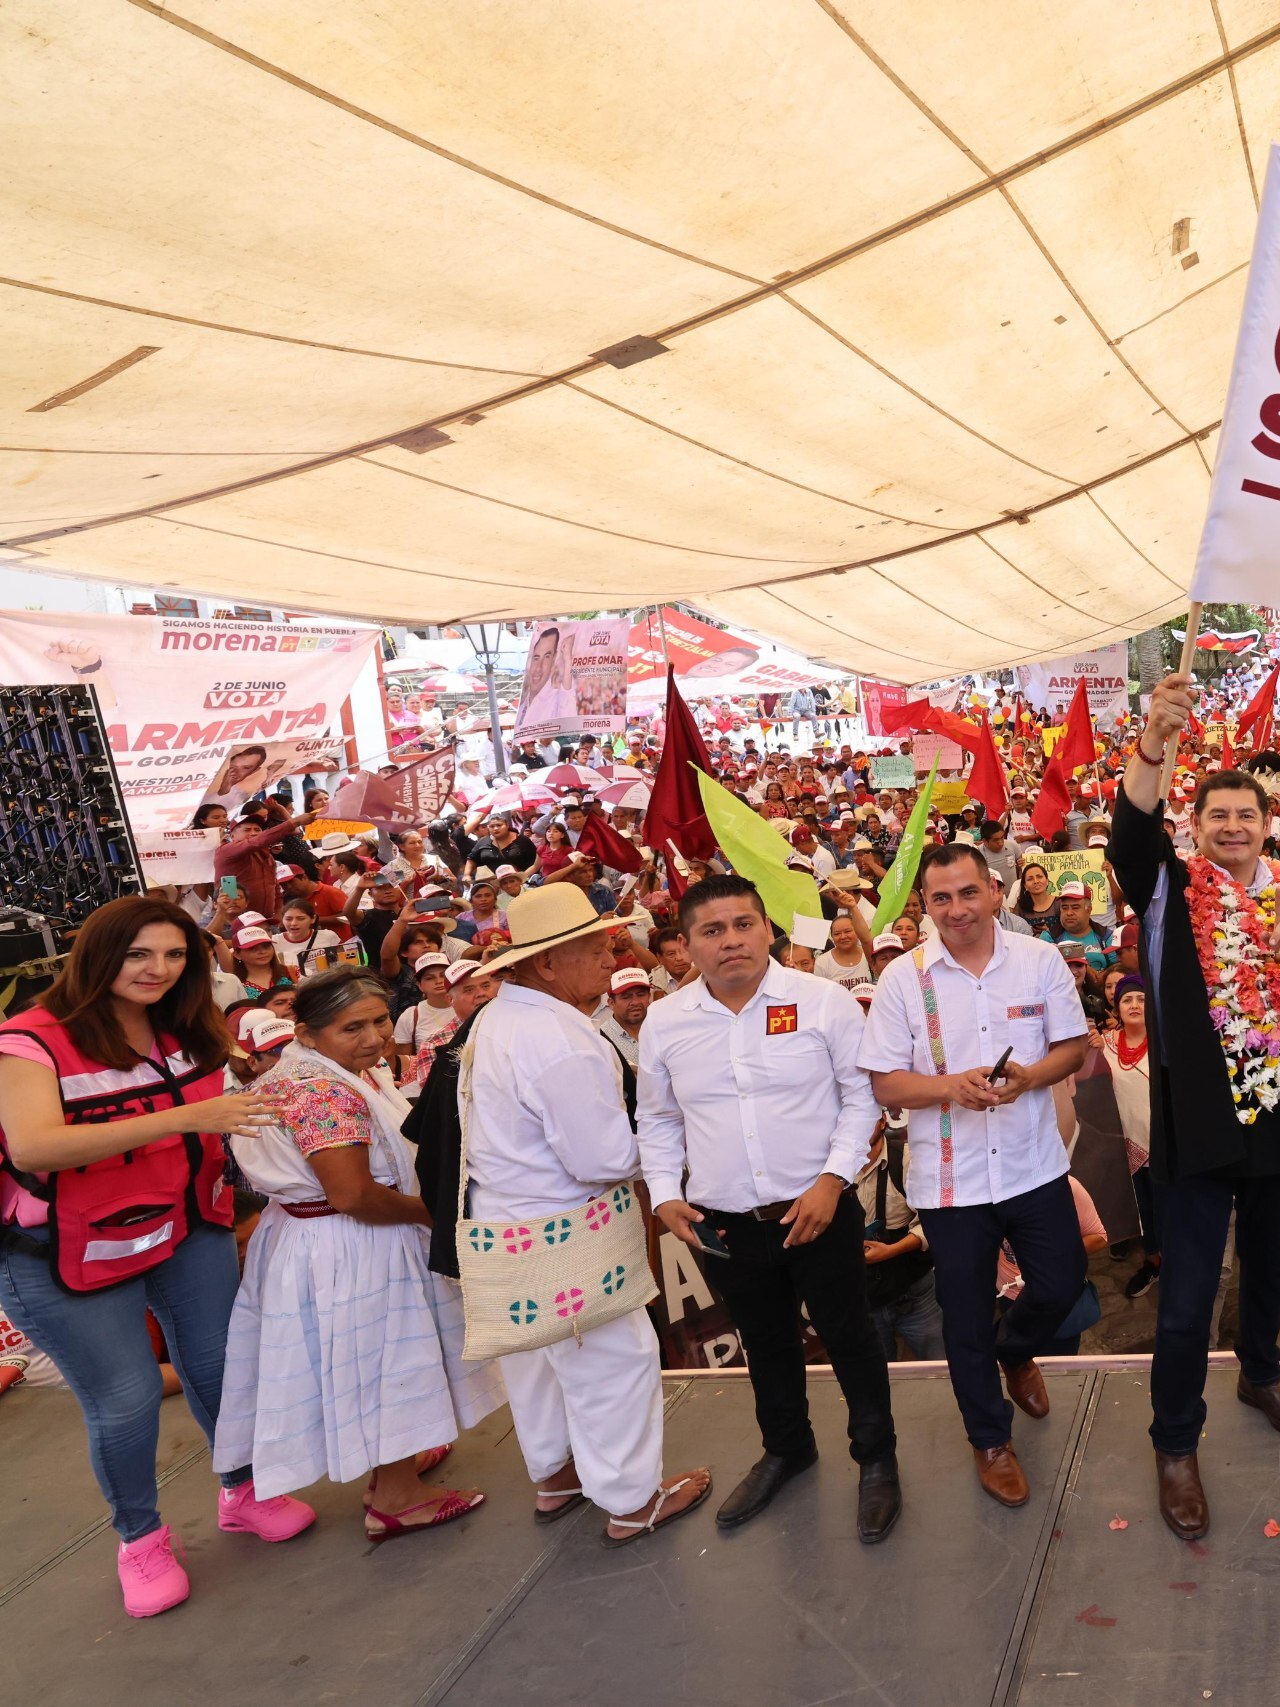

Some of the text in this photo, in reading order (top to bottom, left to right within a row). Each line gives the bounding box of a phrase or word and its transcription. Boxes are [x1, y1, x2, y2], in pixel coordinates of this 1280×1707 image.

[162, 619, 211, 629] SIGAMOS
[213, 623, 264, 631] HACIENDO
[267, 625, 309, 634] HISTORIA
[161, 631, 276, 652] morena
[591, 636, 609, 644] VOTA
[281, 642, 296, 650] PT
[572, 655, 623, 666] PROFE OMAR
[213, 682, 286, 690] 2 DE JUNIO
[1049, 677, 1125, 688] ARMENTA
[208, 692, 281, 707] VOTA
[105, 703, 326, 752] ARMENTA
[583, 719, 610, 728] morena
[295, 739, 344, 752] OLINTLA
[137, 747, 229, 767] GOBERN
[124, 784, 177, 796] AMOR
[164, 830, 205, 838] morena
[839, 976, 869, 987] RMENTA
[260, 1024, 293, 1035] ARMENTA
[769, 1015, 795, 1033] PT
